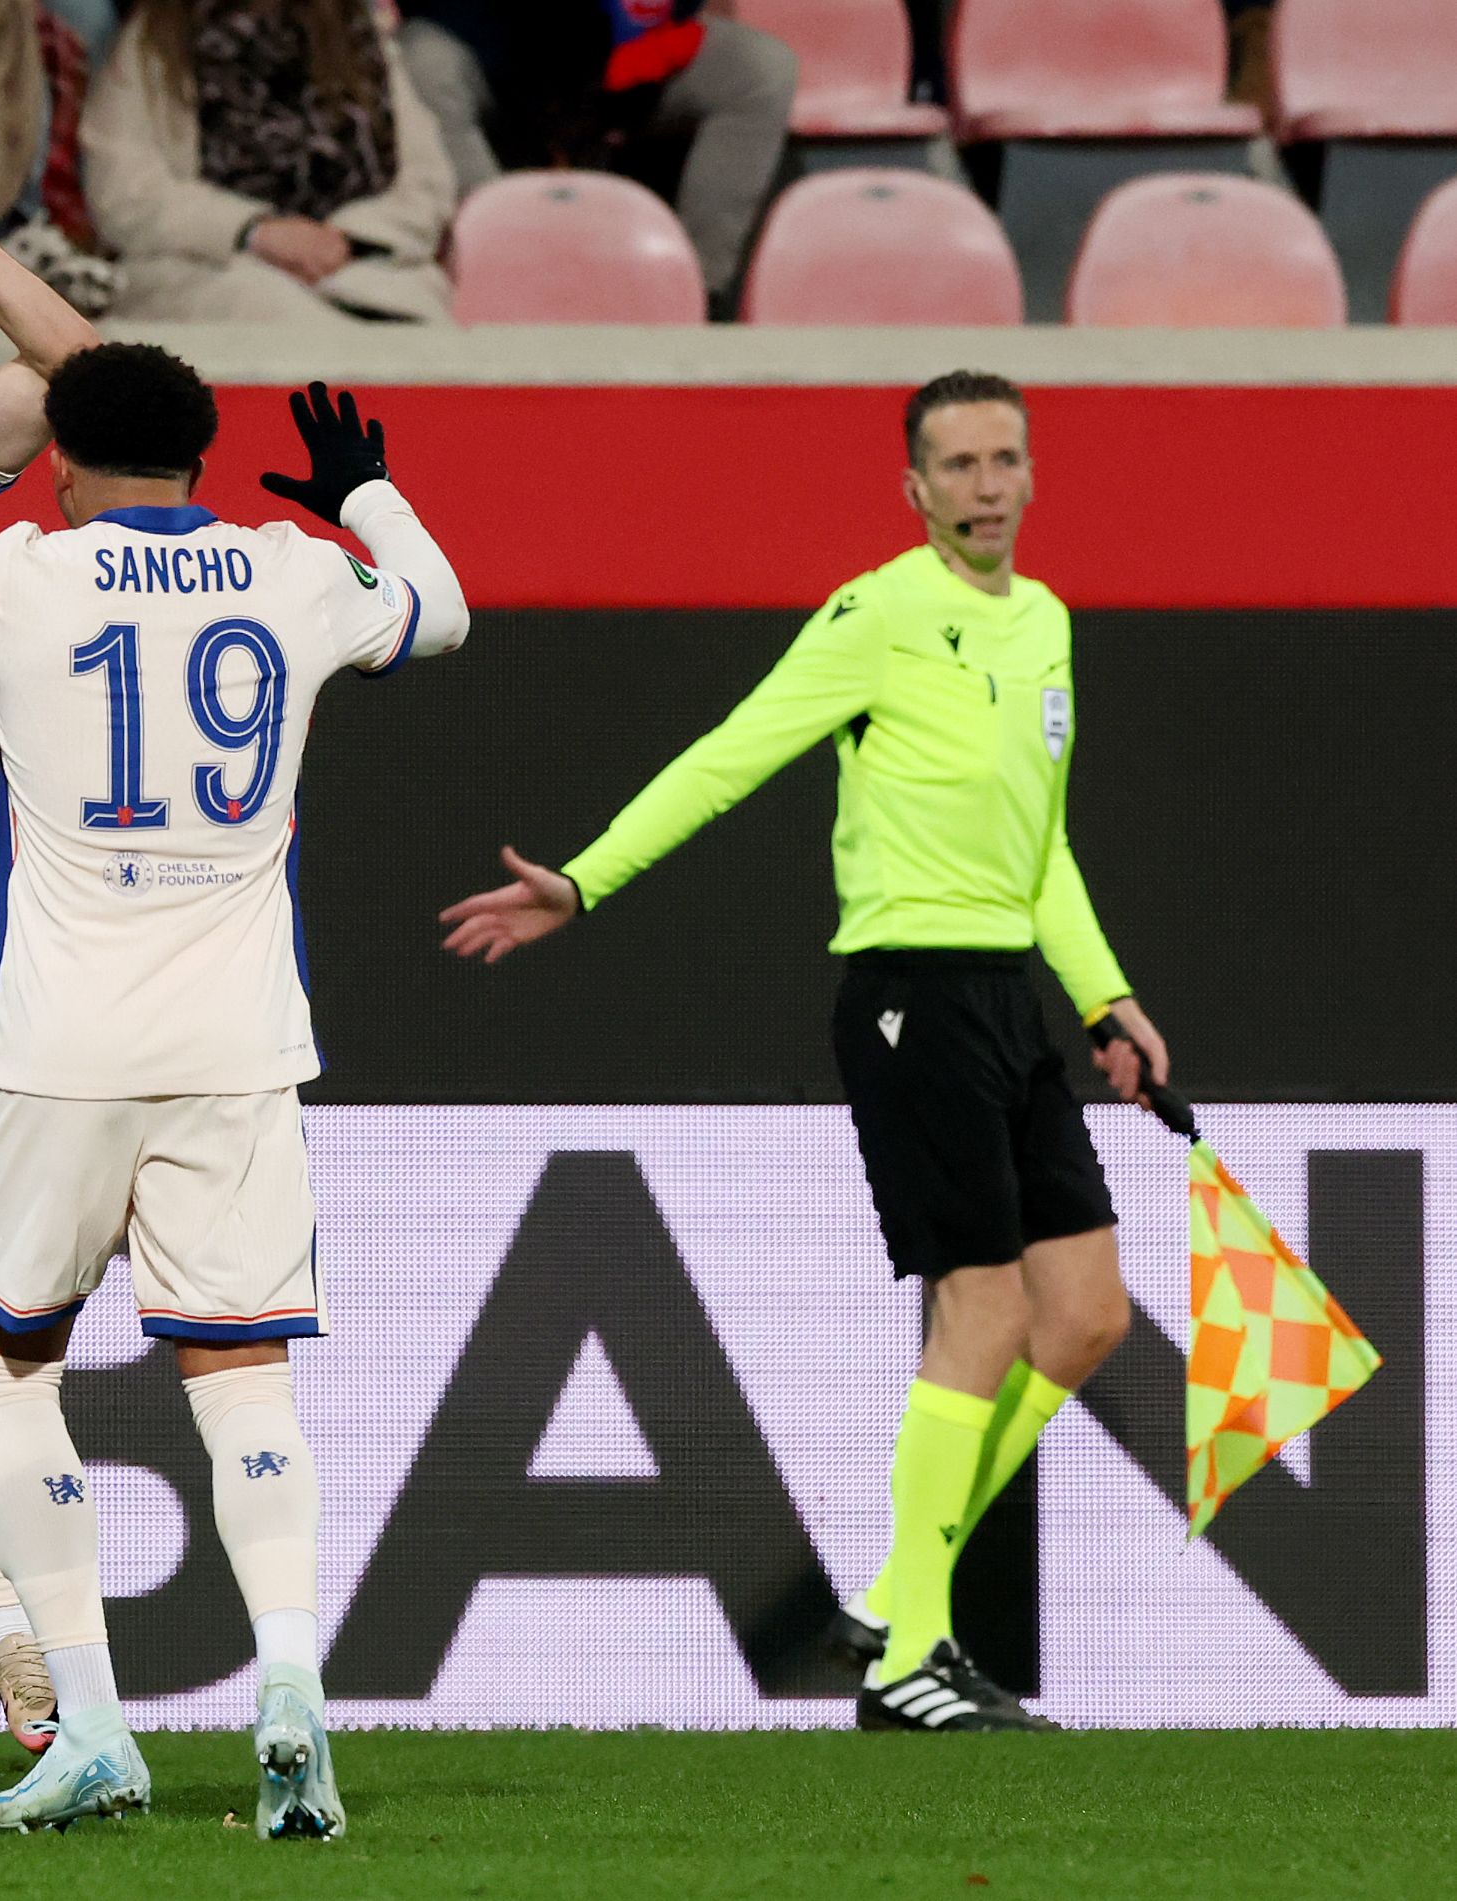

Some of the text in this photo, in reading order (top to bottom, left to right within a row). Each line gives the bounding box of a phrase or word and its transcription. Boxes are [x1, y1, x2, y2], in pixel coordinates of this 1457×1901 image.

[94, 546, 253, 594] SANCHO
[69, 615, 290, 832] 19
[157, 862, 217, 874] CHELSEA
[158, 872, 244, 887] FOUNDATION
